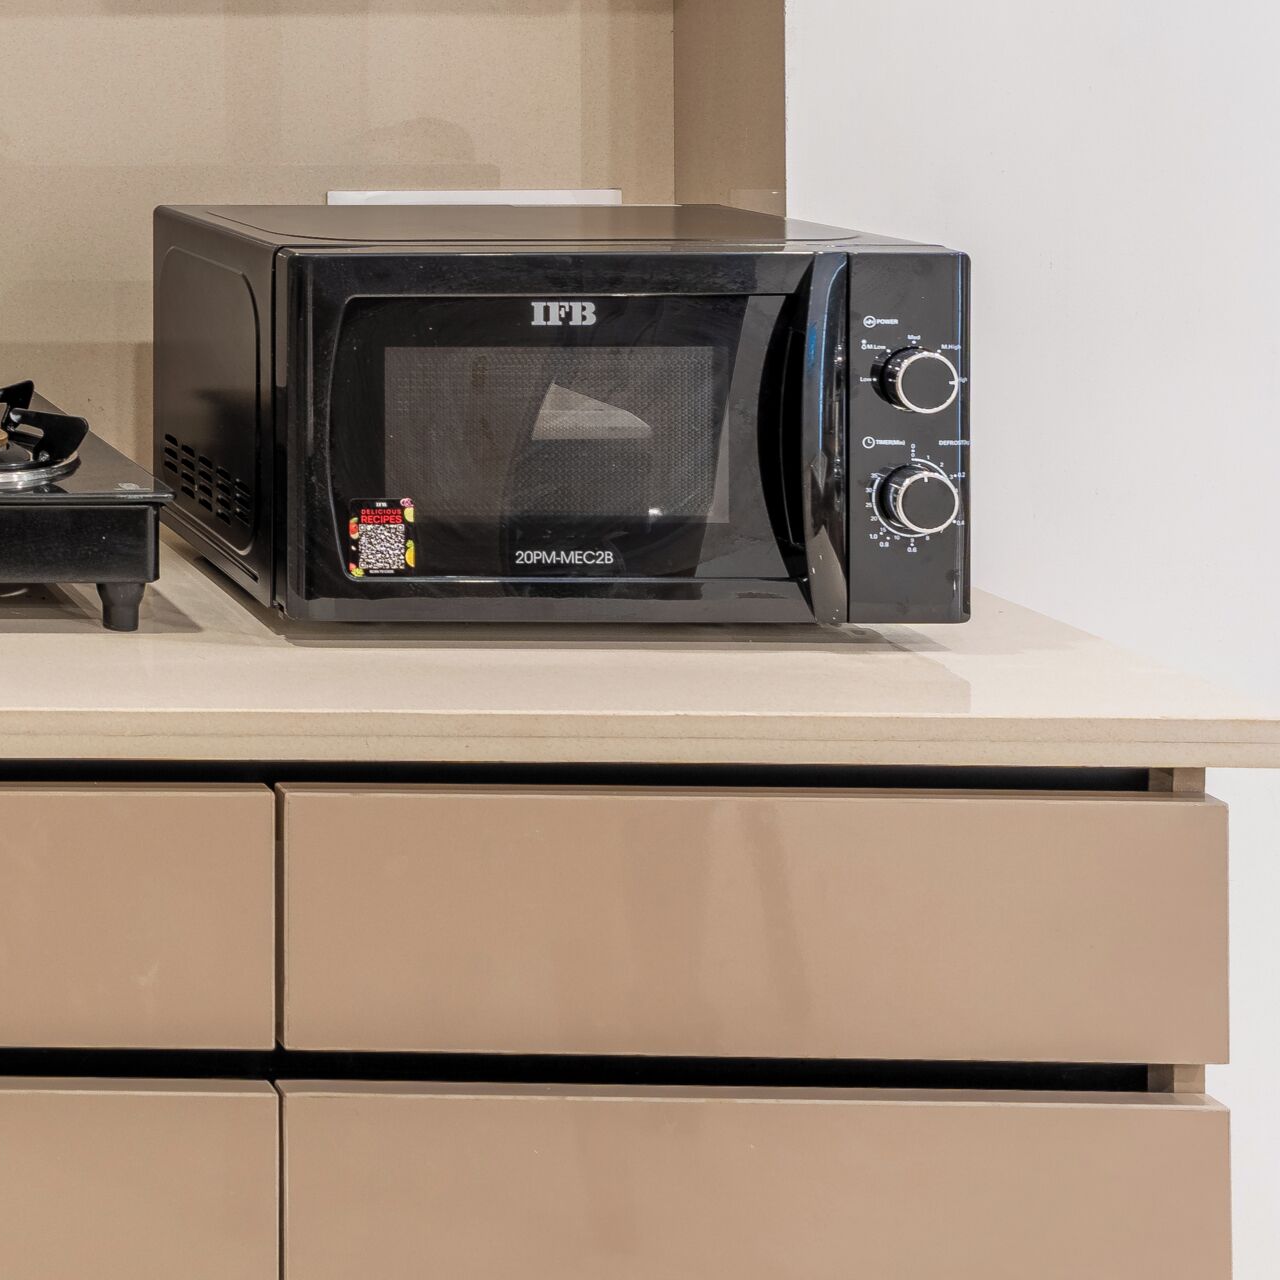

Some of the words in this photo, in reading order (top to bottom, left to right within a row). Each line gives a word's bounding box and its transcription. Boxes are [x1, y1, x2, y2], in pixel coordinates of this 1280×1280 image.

[531, 301, 597, 325] IFB
[361, 515, 402, 523] RECIPES
[515, 551, 614, 564] 20PM-MEC2B
